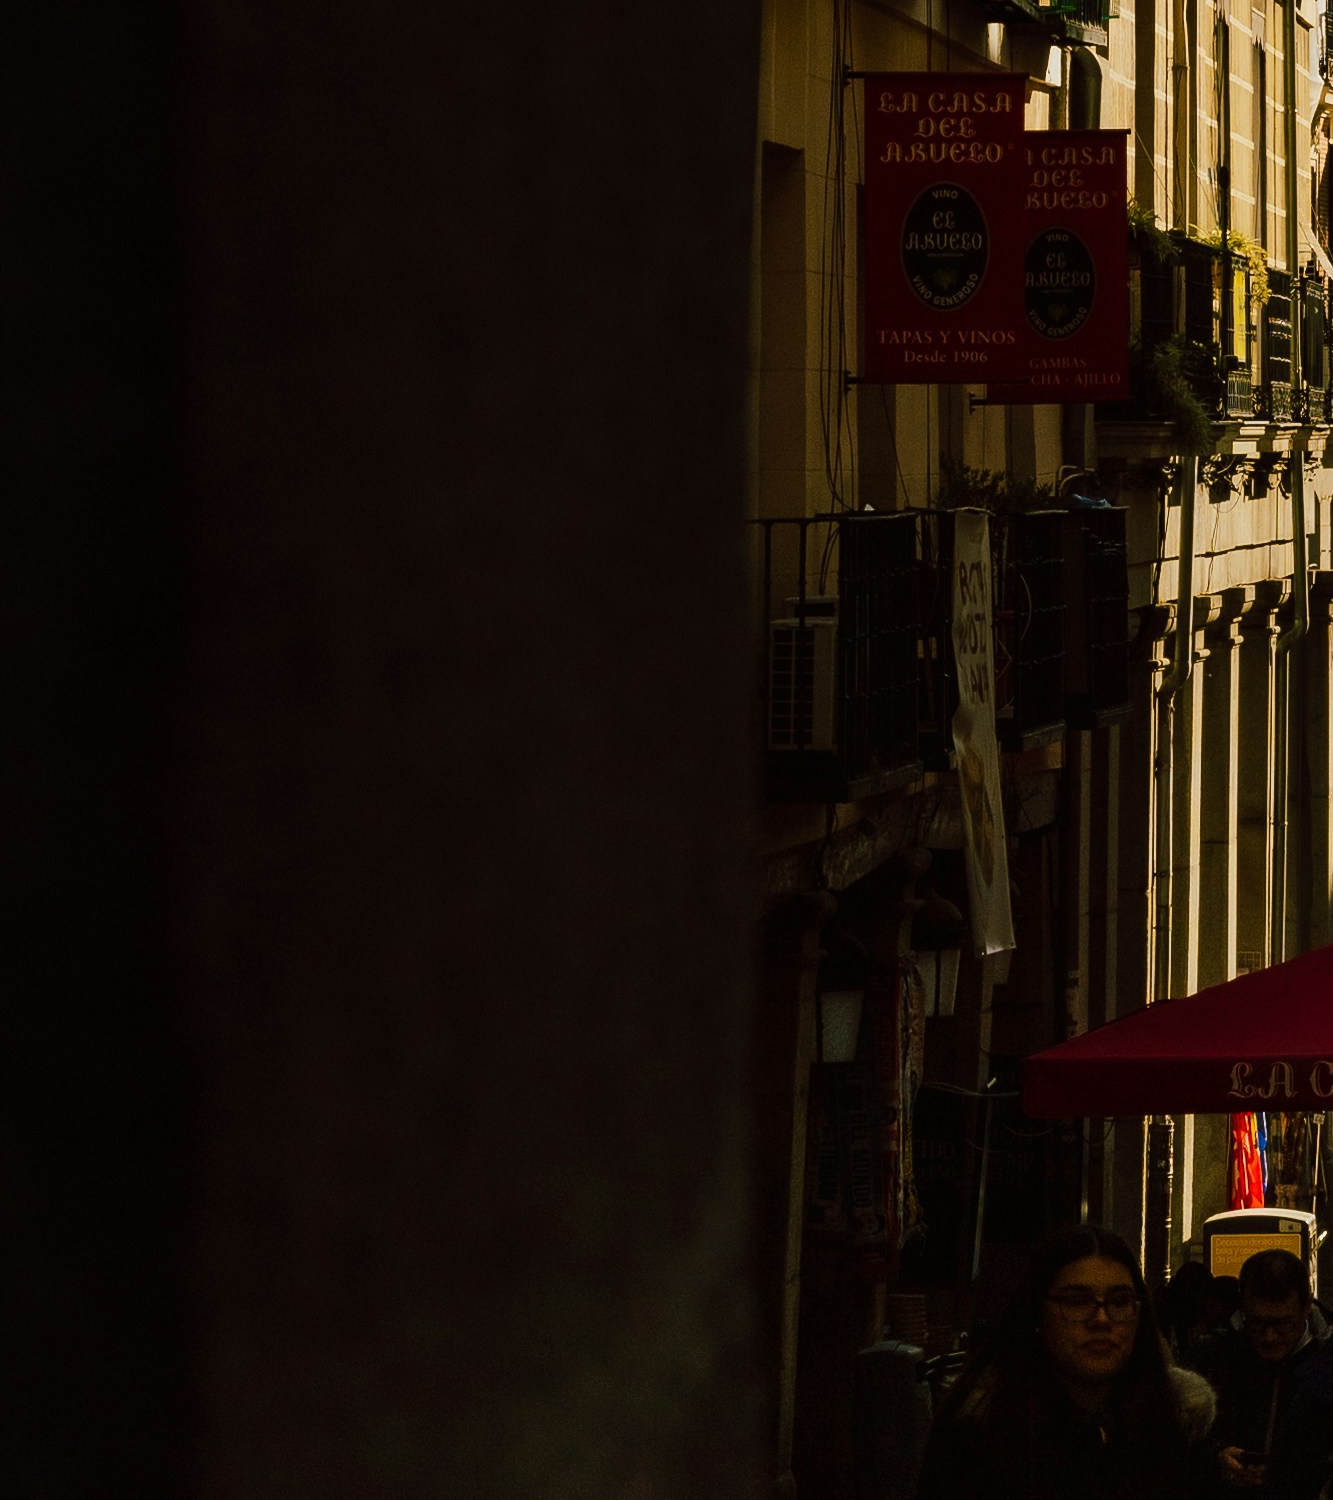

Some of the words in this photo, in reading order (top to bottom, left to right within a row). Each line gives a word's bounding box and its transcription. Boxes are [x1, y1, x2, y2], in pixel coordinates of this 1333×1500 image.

[877, 91, 919, 113] LA
[928, 91, 1012, 113] CASA
[914, 117, 977, 138] DEL
[880, 142, 1003, 163] ABUELO
[1041, 146, 1116, 165] CASA
[1029, 168, 1085, 188] DEL
[930, 190, 959, 200] VINO
[1025, 190, 1108, 209] BUELO
[932, 210, 956, 230] EL
[905, 231, 983, 251] ABUELO
[1045, 252, 1067, 270] EL
[911, 274, 931, 300] VINO
[933, 272, 979, 306] GENEROSO
[877, 329, 934, 345] TAPAS
[938, 329, 951, 345] Y
[956, 329, 1016, 345] VINOS
[903, 350, 947, 364] Desde
[952, 350, 989, 364] 1906
[1028, 356, 1087, 370] GAMBAS
[1074, 372, 1121, 387] AJILLO
[1227, 1060, 1298, 1098] LA
